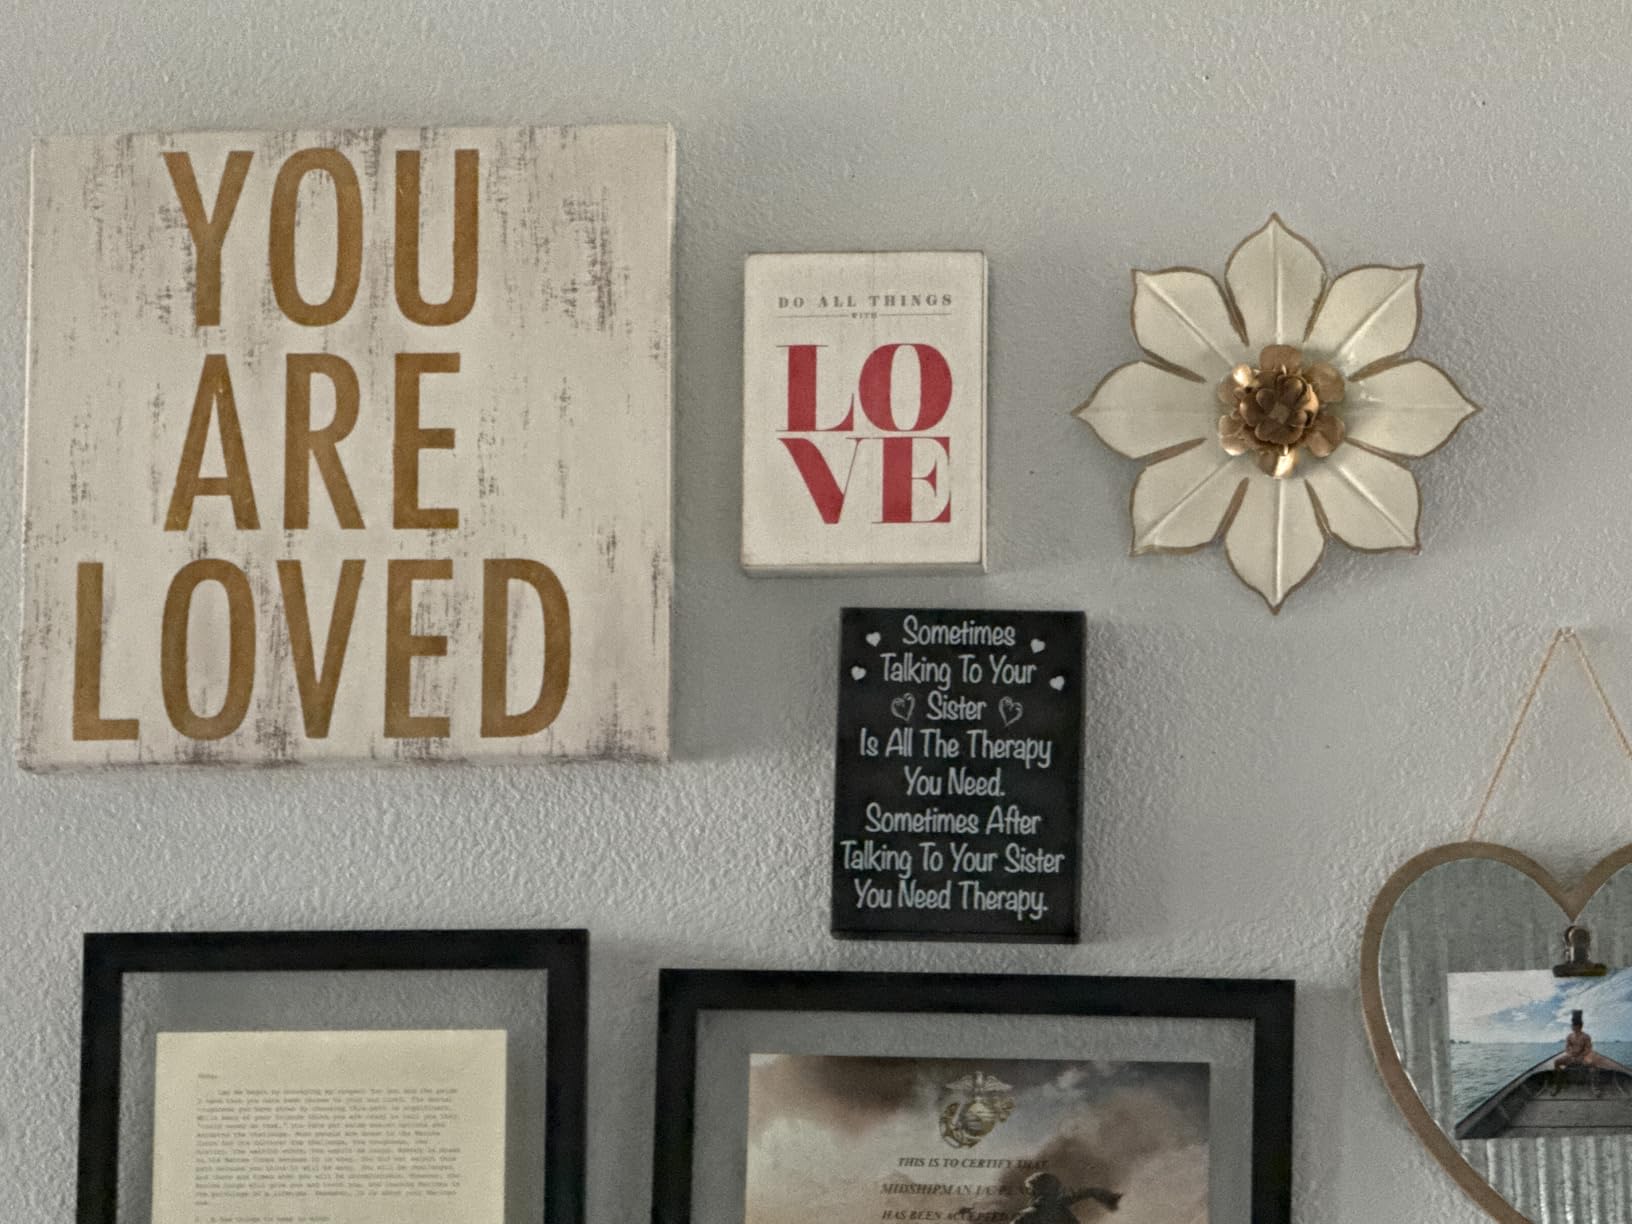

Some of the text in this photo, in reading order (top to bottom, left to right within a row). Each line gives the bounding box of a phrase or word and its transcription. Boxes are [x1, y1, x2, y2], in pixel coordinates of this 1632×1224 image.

[161, 147, 480, 328] YOU
[778, 294, 952, 309] DO ALL THINGS
[851, 311, 878, 319] WITH
[164, 352, 460, 532] ARE
[902, 614, 1016, 646] Sometimes
[73, 558, 571, 741] LOVED
[880, 652, 1037, 691] Talking To Your
[926, 690, 987, 721] Sister
[859, 727, 1053, 769] Is All The Therapy
[904, 766, 1005, 797] You Need.
[865, 802, 1042, 835] Sometimes After
[840, 840, 1065, 879] Talking To Your Sister
[854, 878, 1049, 921] You Need Therapy.
[898, 1157, 926, 1168] THIS
[928, 1158, 940, 1168] IS
[943, 1158, 959, 1168] TO
[960, 1158, 1012, 1169] CERTIFY
[909, 1210, 941, 1221] BEEN
